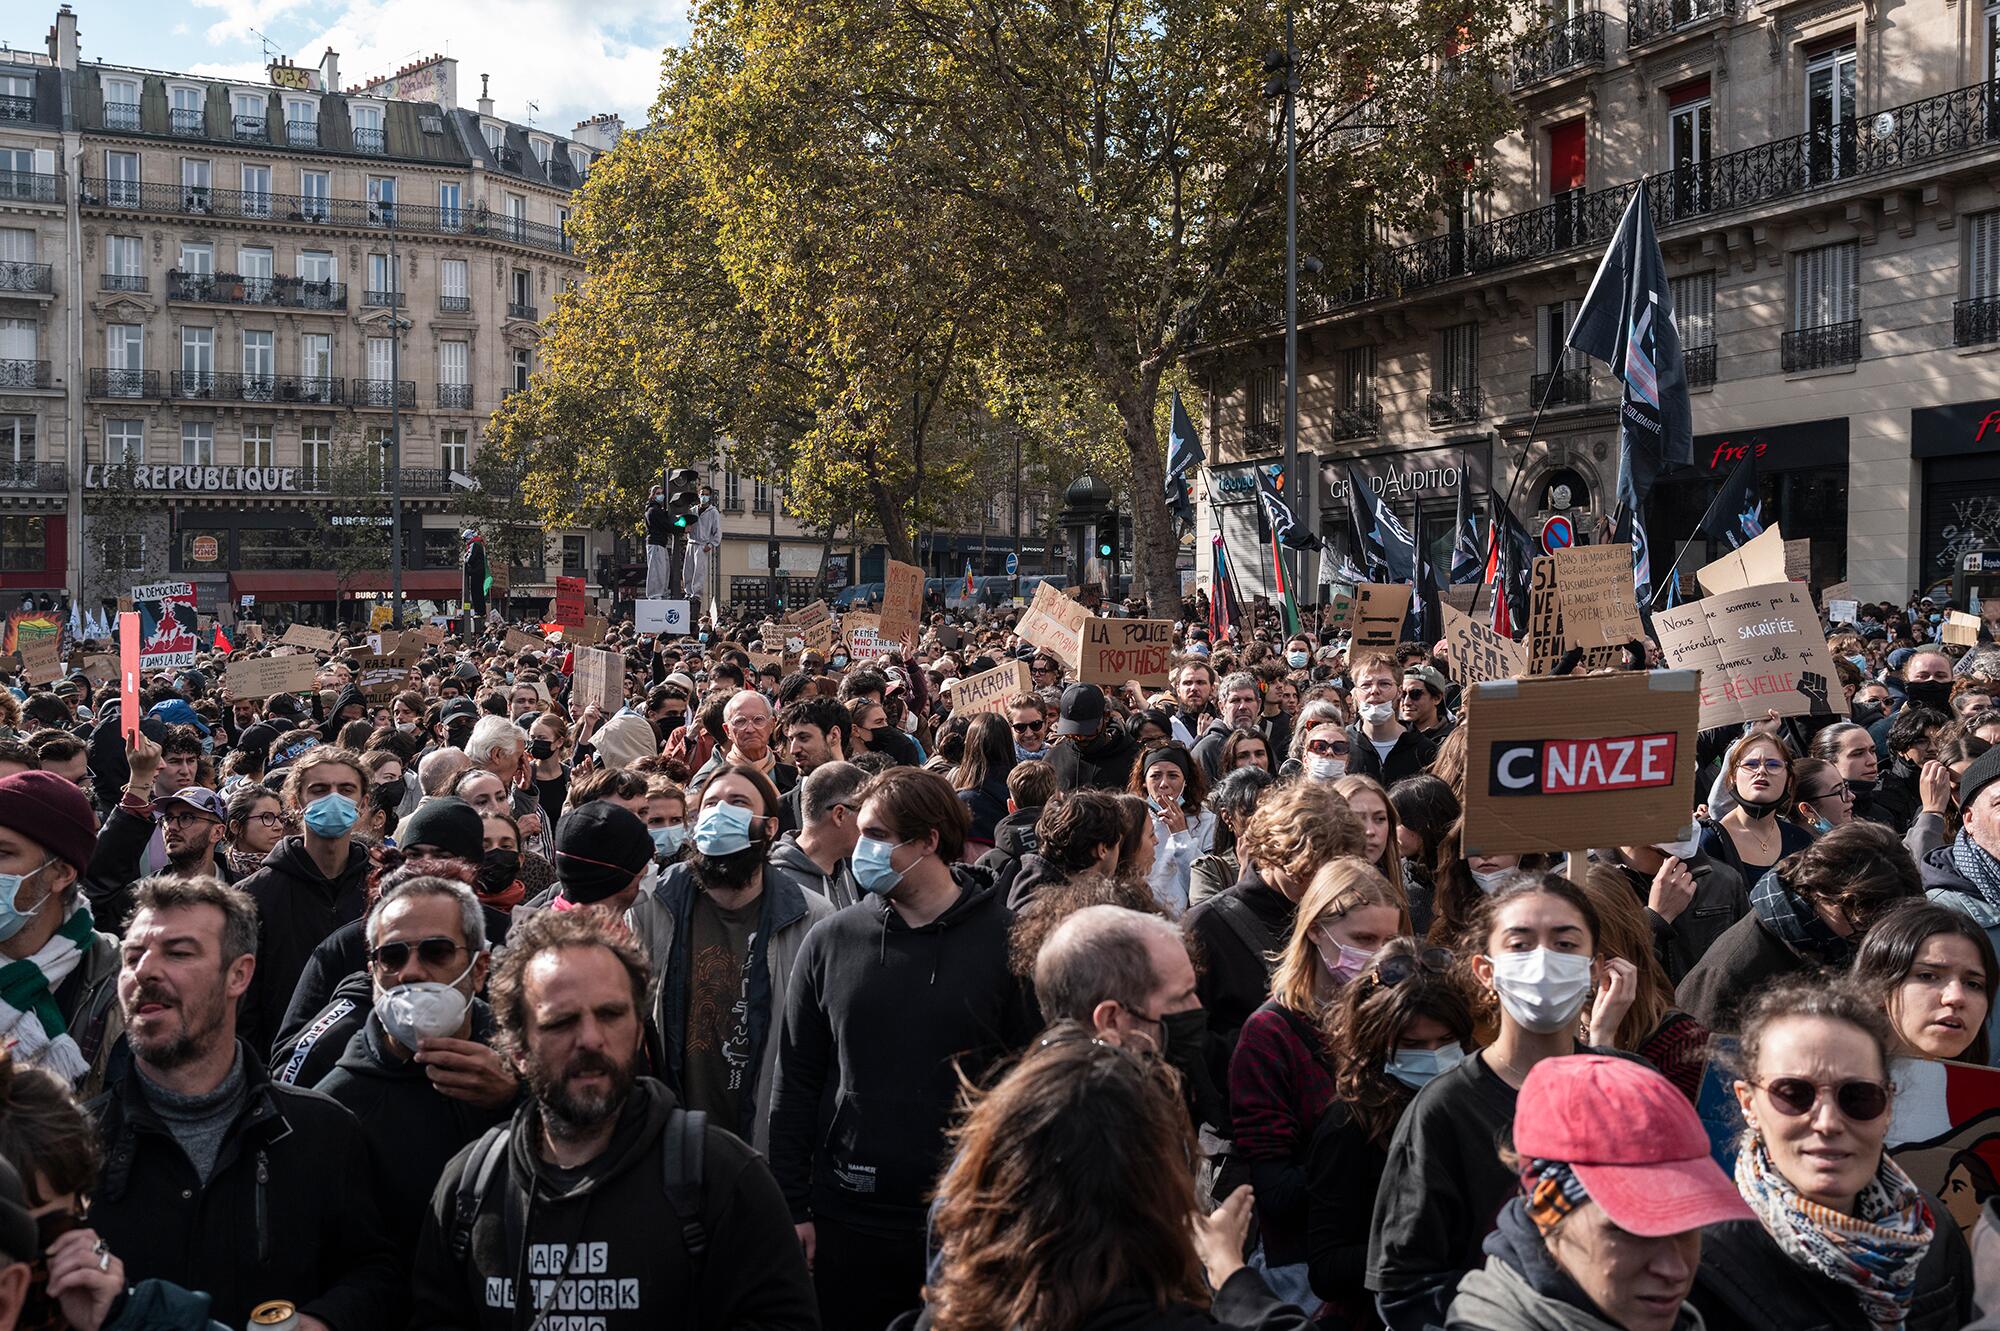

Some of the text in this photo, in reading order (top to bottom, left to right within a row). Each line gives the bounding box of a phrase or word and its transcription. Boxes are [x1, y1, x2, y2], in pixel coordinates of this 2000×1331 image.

[1624, 404, 1662, 435] SOLIDARITÉ
[1710, 440, 1768, 469] free
[194, 549, 217, 557] KING
[134, 588, 144, 600] LA
[1560, 578, 1595, 592] ENSEMBLE
[1562, 595, 1573, 607] LE
[1574, 592, 1600, 604] MONDE
[1568, 604, 1605, 624] SYSTÈME
[1662, 592, 1800, 633] Nous ne sommes pas la
[854, 638, 872, 647] WHO
[873, 638, 888, 647] THE
[1091, 624, 1110, 645] LA
[1470, 621, 1503, 650] QUI
[146, 655, 163, 667] DANS
[164, 654, 174, 666] LA
[175, 653, 193, 665] RUE
[1672, 635, 1727, 662] génération
[1715, 657, 1753, 672] sommes
[1762, 646, 1789, 663] celle
[1799, 647, 1814, 665] qui
[959, 667, 1015, 706] MACRON
[1698, 671, 1796, 706] E RÉVEILLE
[1546, 737, 1669, 789] NAZE
[321, 1008, 346, 1027] FILA
[283, 1053, 305, 1084] FILA
[532, 1248, 605, 1270] ARIS
